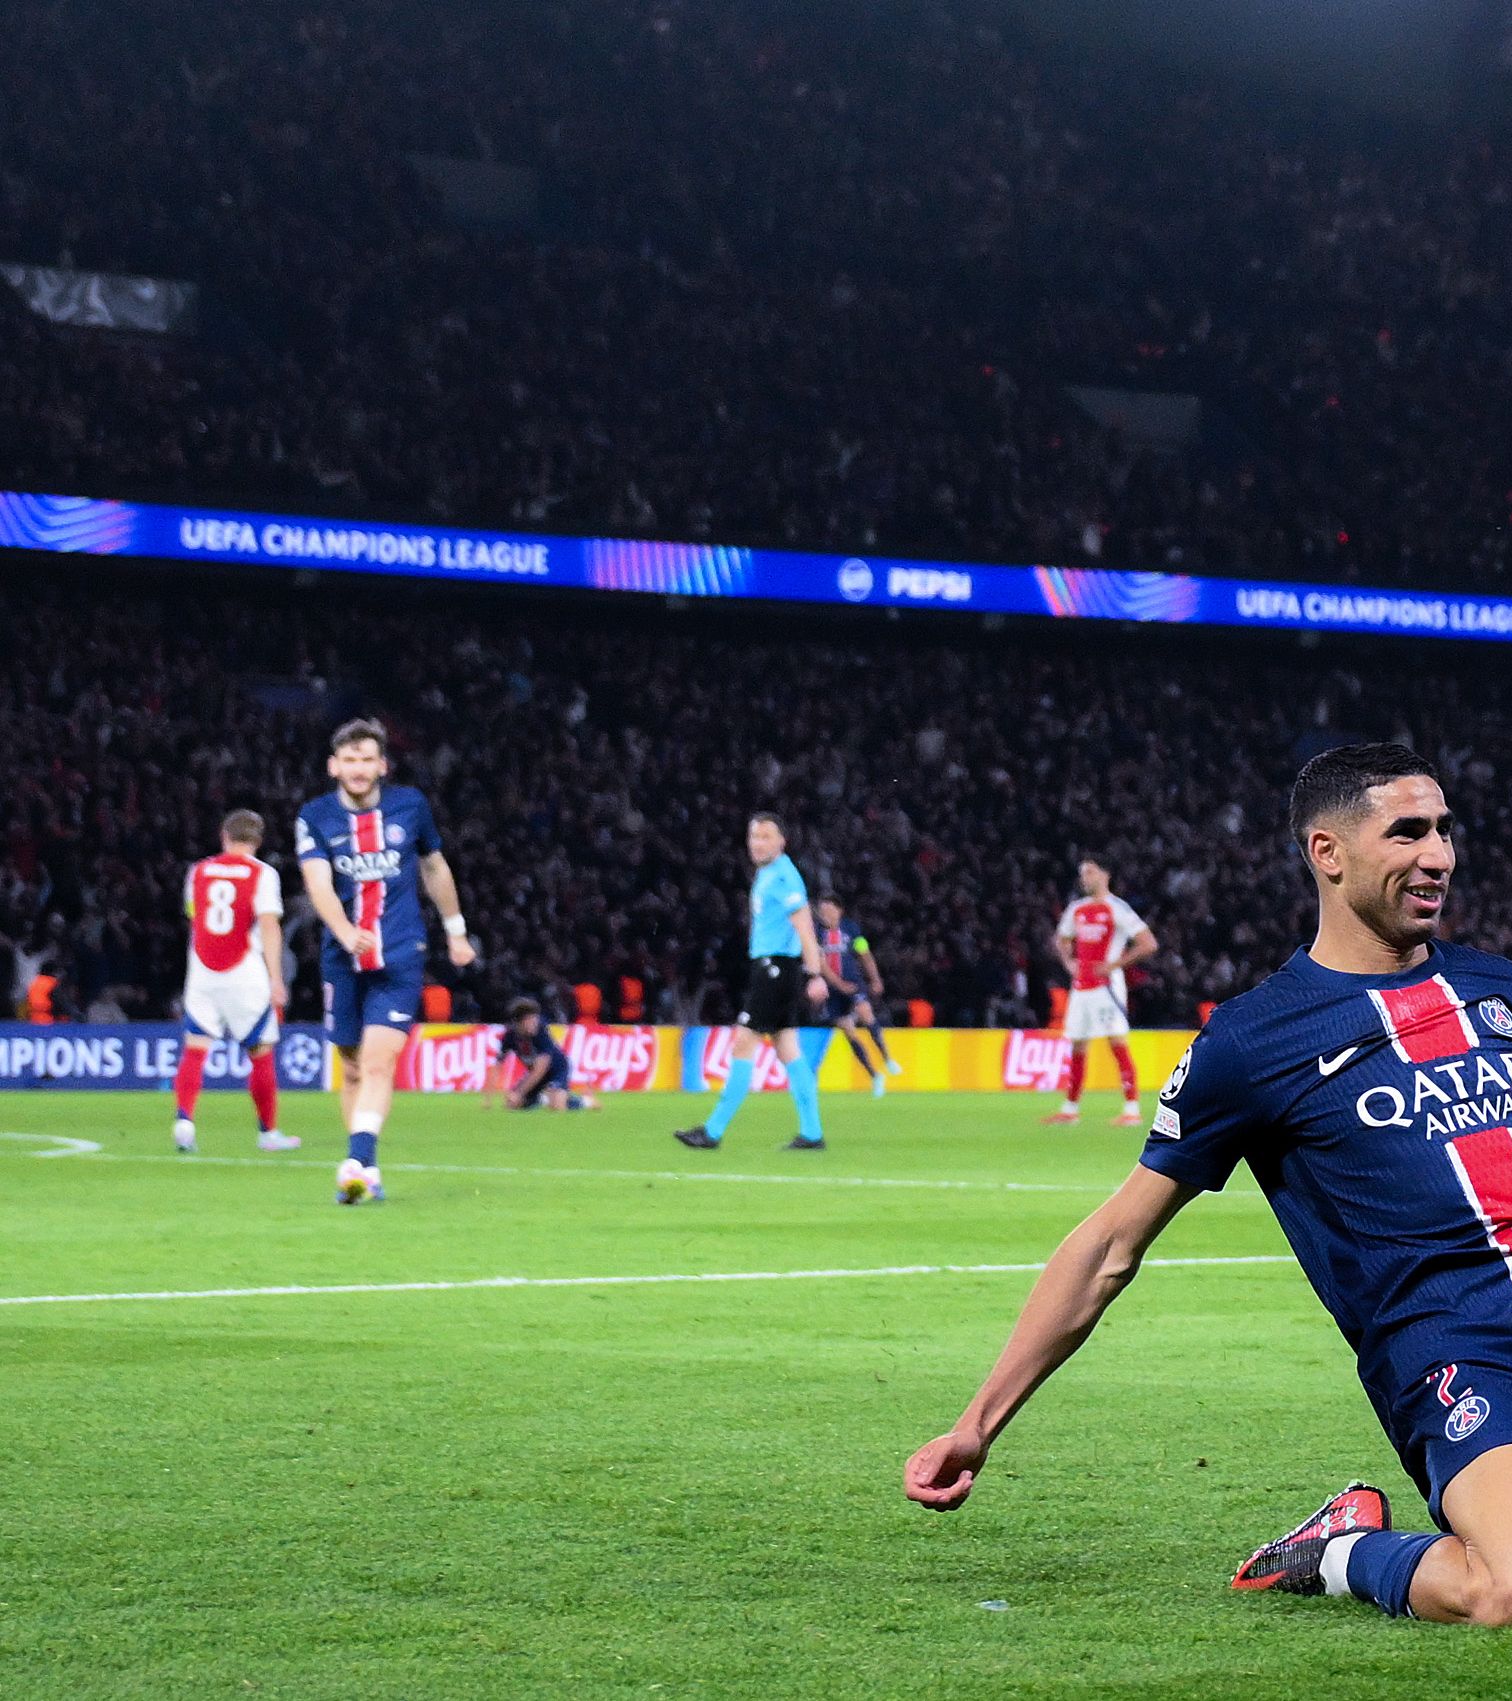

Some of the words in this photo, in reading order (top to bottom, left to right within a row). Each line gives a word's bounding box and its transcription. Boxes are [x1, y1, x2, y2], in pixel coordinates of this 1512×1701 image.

[179, 516, 258, 553] UEFA
[261, 523, 436, 568] CHAMPIONS
[438, 537, 549, 576] LEAGUE
[887, 566, 972, 602] PEPSI
[1236, 588, 1301, 620] UEFA
[1303, 592, 1448, 630] CHAMPIONS
[334, 849, 401, 877] QATAR
[205, 879, 237, 935] 8
[135, 1037, 254, 1078] LEGU
[421, 1023, 506, 1092] Lays
